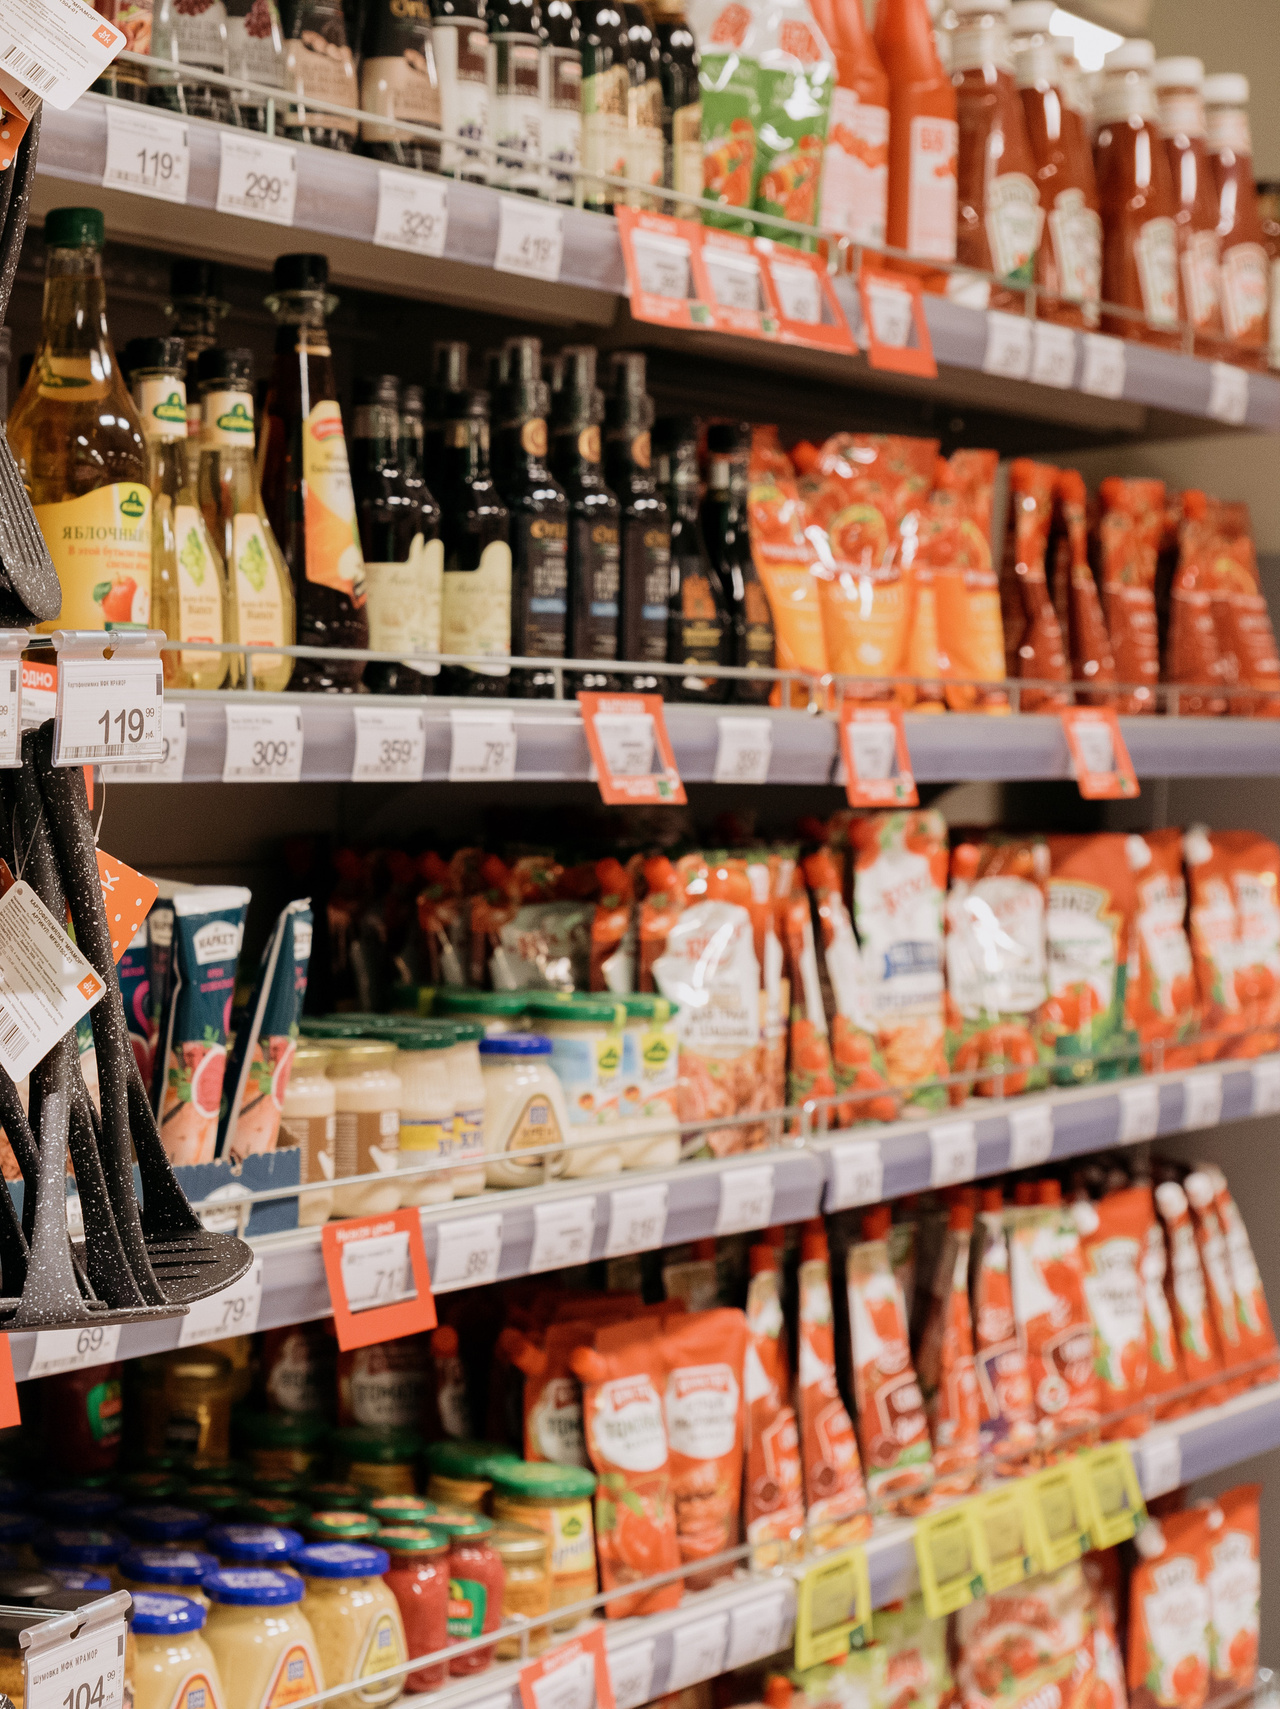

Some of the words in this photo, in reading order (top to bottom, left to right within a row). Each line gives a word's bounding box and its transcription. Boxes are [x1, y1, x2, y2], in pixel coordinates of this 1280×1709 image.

[136, 147, 175, 179] 119
[245, 171, 282, 204] 299
[401, 210, 435, 239] 329
[97, 708, 145, 745] 119
[145, 707, 155, 718] 99
[251, 739, 289, 767] 309
[378, 740, 412, 766] 359
[484, 741, 506, 765] 79
[222, 1297, 246, 1323] 79
[76, 1327, 104, 1354] 69
[32, 1668, 60, 1686] Шумовка
[60, 1661, 74, 1675] МФК
[74, 1648, 99, 1667] МРАМОР
[62, 1675, 106, 1708] 104
[106, 1670, 116, 1682] 99
